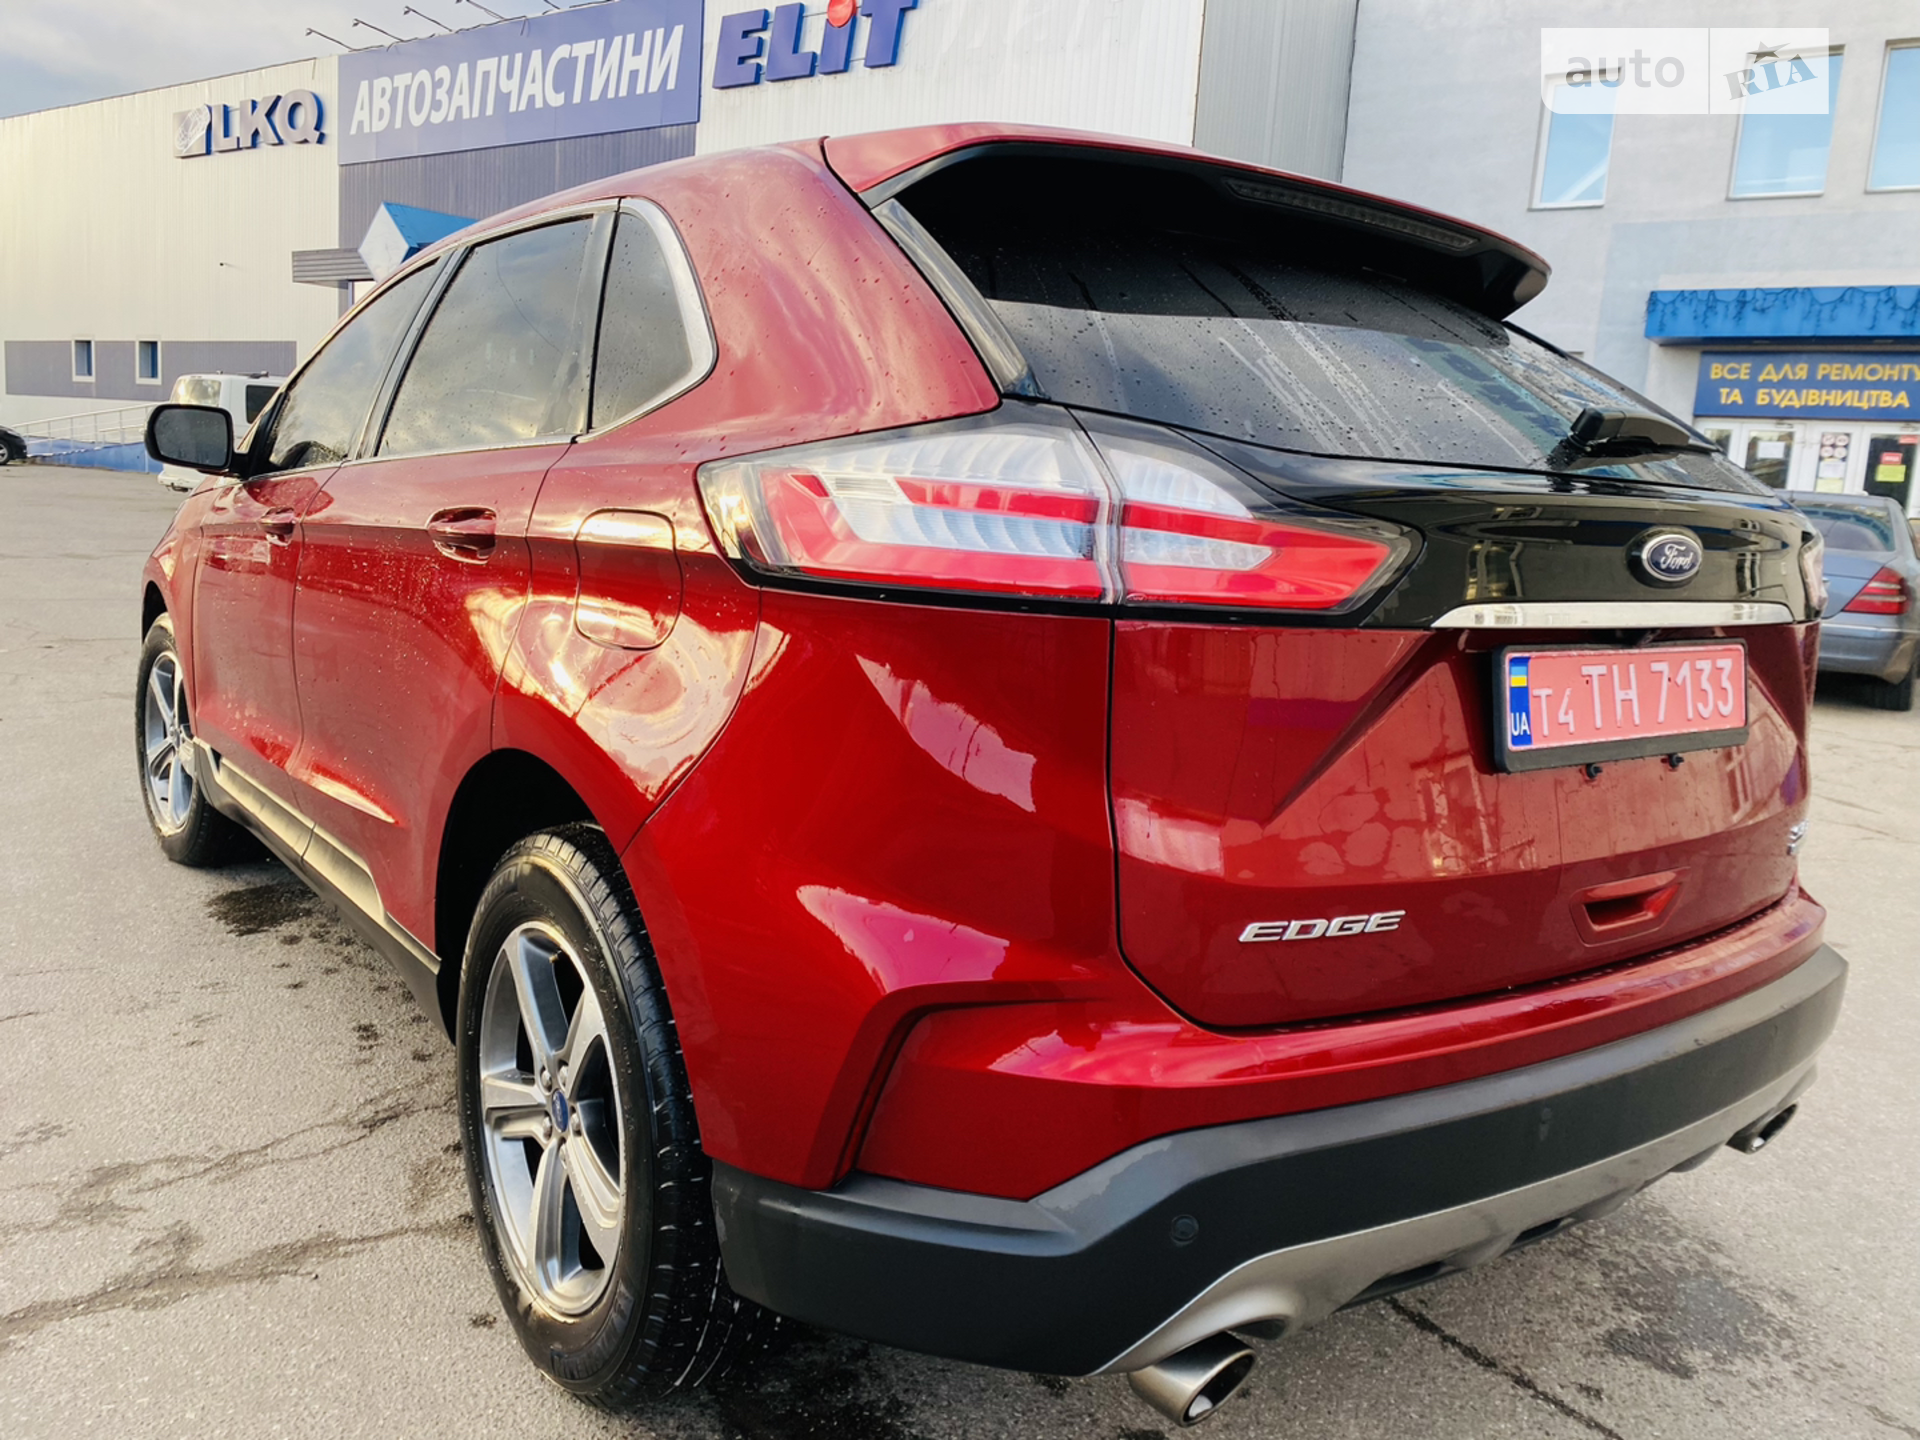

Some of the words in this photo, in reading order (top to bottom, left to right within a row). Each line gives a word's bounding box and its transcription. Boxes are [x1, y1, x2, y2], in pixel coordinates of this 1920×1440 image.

[349, 23, 685, 136] АВТОЗАПЧАСТИНИ
[212, 89, 326, 153] LKQ
[1709, 363, 1752, 380] ВСЕ
[1758, 363, 1809, 382] ДЛЯ
[1719, 388, 1743, 405] ТА
[1756, 388, 1910, 410] БУДІВНИЦТВА
[1660, 543, 1694, 570] Ford
[1533, 688, 1575, 737] T4
[1650, 658, 1734, 724] 7133
[1511, 712, 1530, 736] UA
[1238, 909, 1406, 943] EDGE
